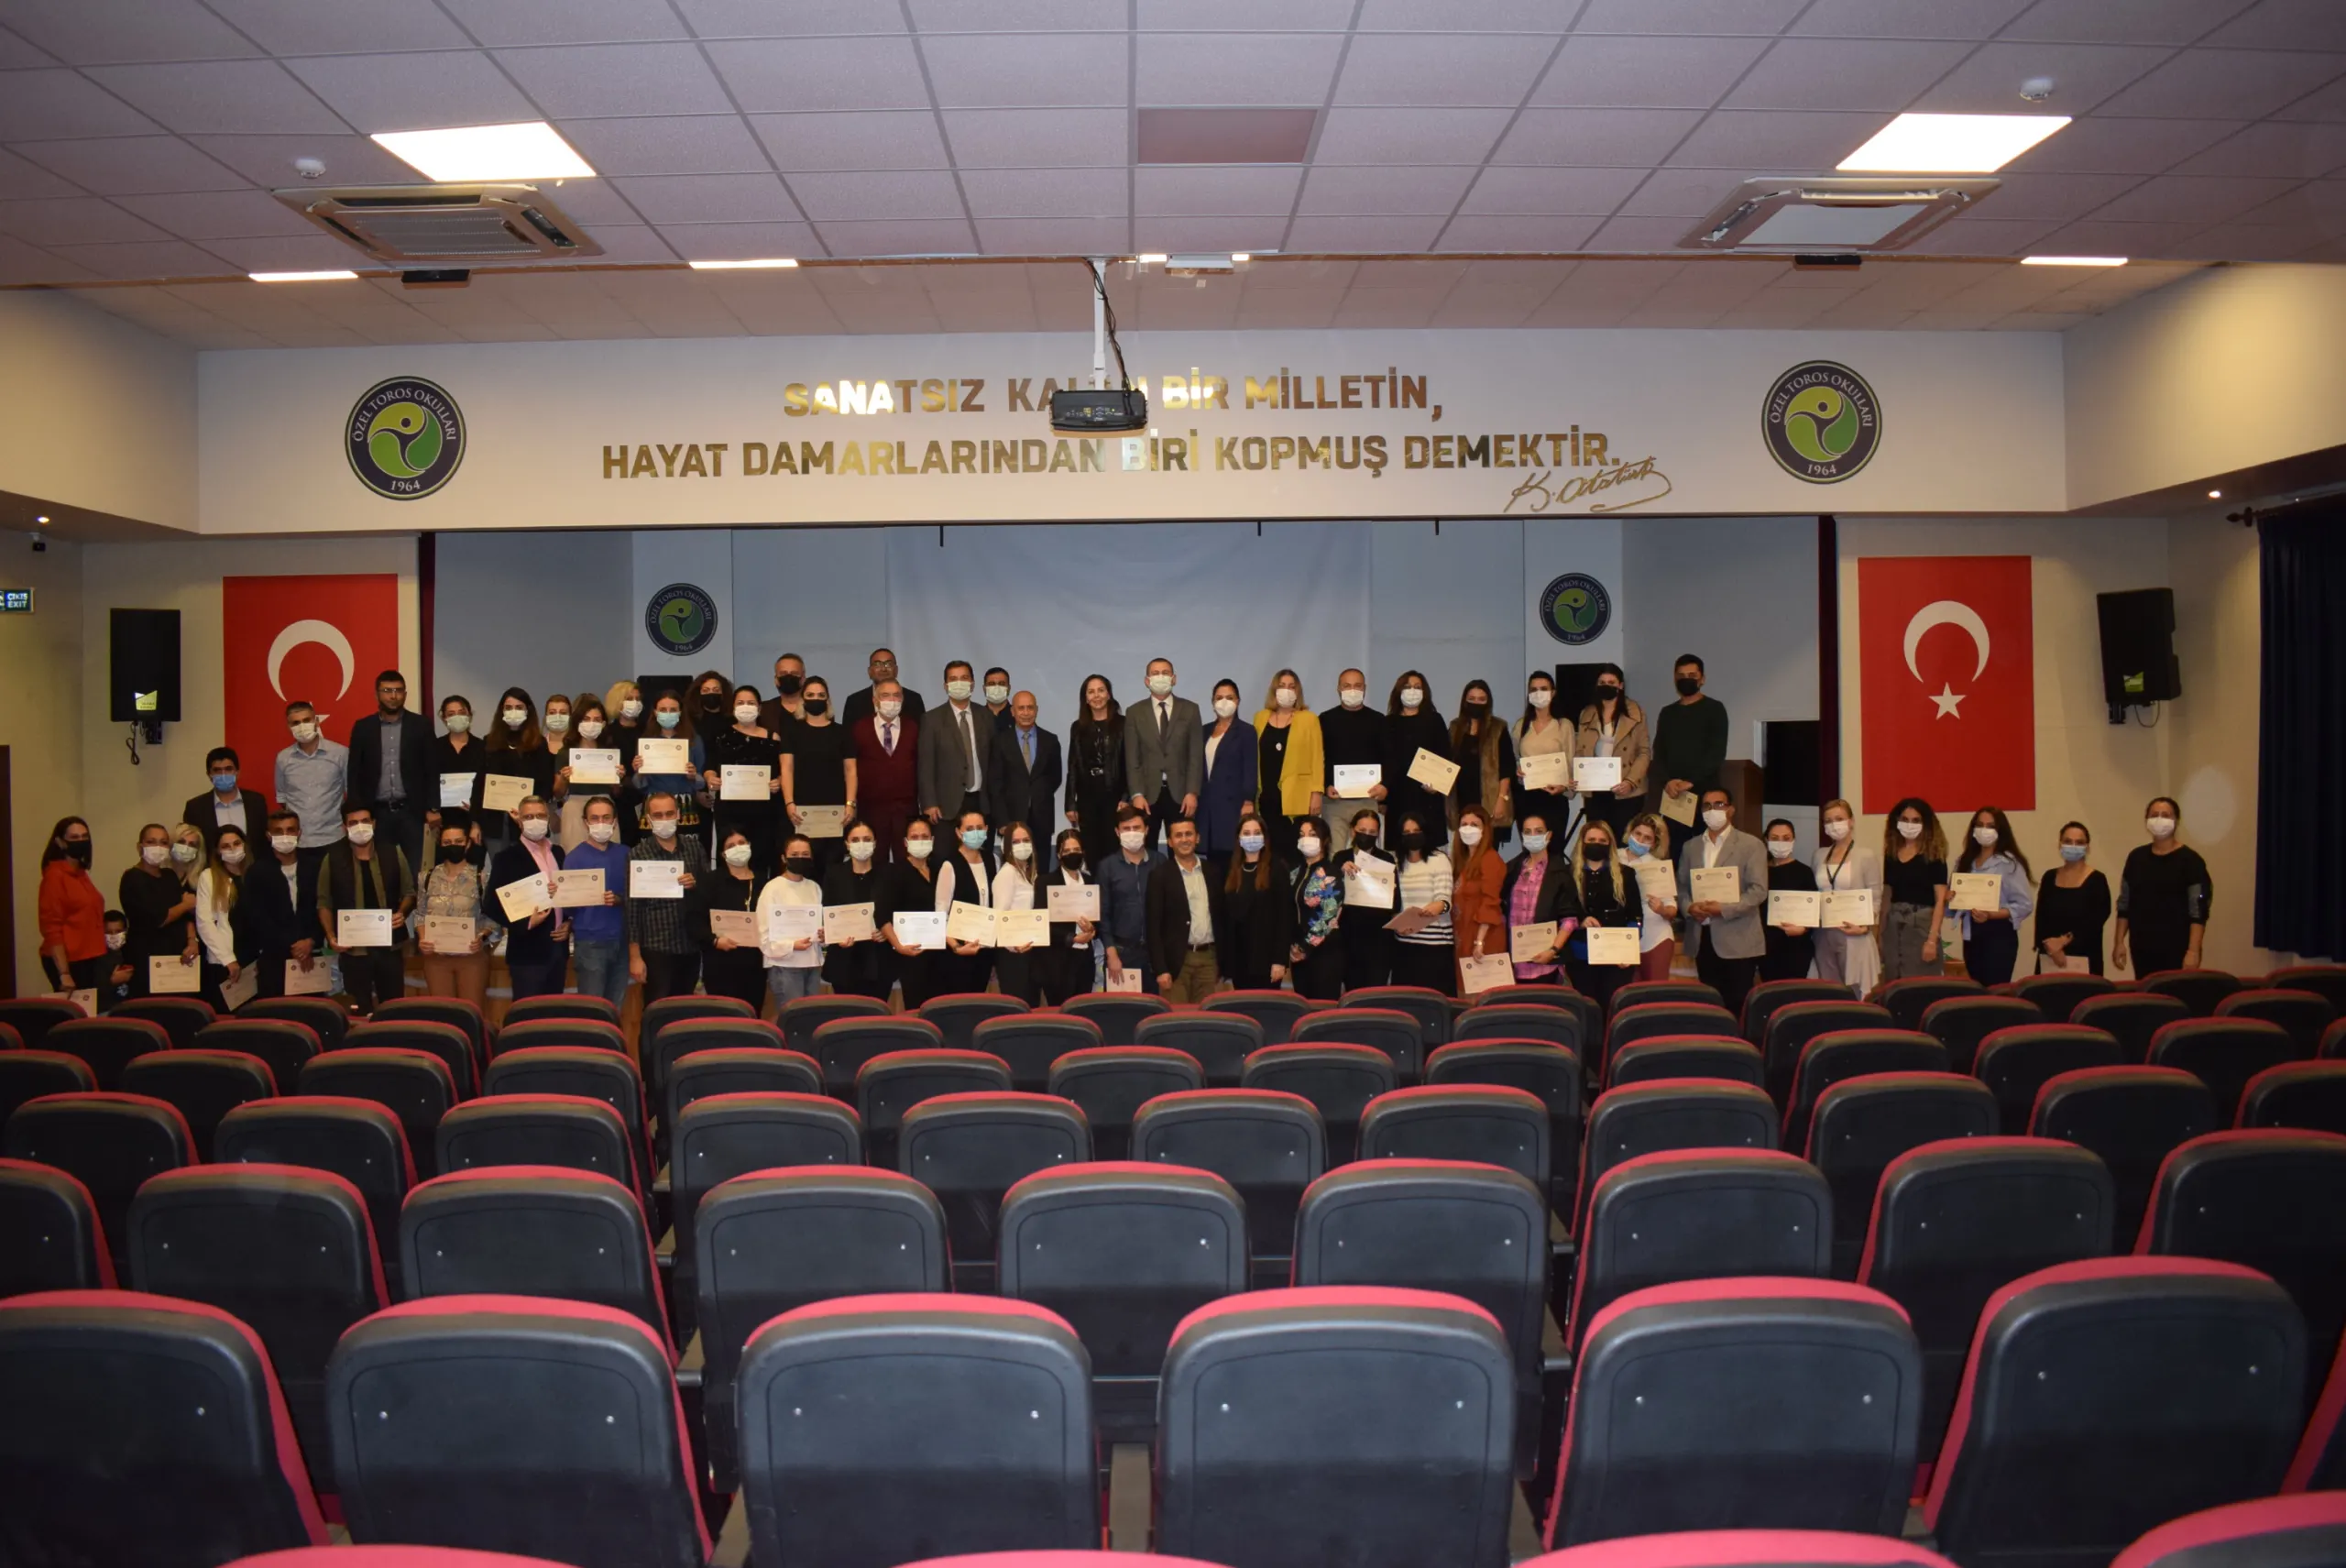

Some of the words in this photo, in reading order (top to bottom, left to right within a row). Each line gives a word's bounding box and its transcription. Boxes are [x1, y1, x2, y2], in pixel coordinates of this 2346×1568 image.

[352, 409, 373, 442] ÖZEL
[367, 388, 411, 411] TOROS
[414, 389, 456, 440] OKULLARI
[784, 378, 985, 417] SANATSIZ
[1162, 367, 1230, 410] BİR
[1245, 366, 1442, 422] MİLLETİN,
[1785, 371, 1829, 394] TOROS
[1831, 374, 1873, 427] OKULLARI
[602, 443, 728, 478] HAYAT
[742, 437, 1106, 476] DAMARLARINDAN
[1122, 428, 1200, 473] BİRİ
[1215, 434, 1389, 478] KOPMUŞ
[1404, 424, 1620, 470] DEMEKTİR.
[1806, 464, 1836, 477] 1964
[390, 479, 421, 492] 1964
